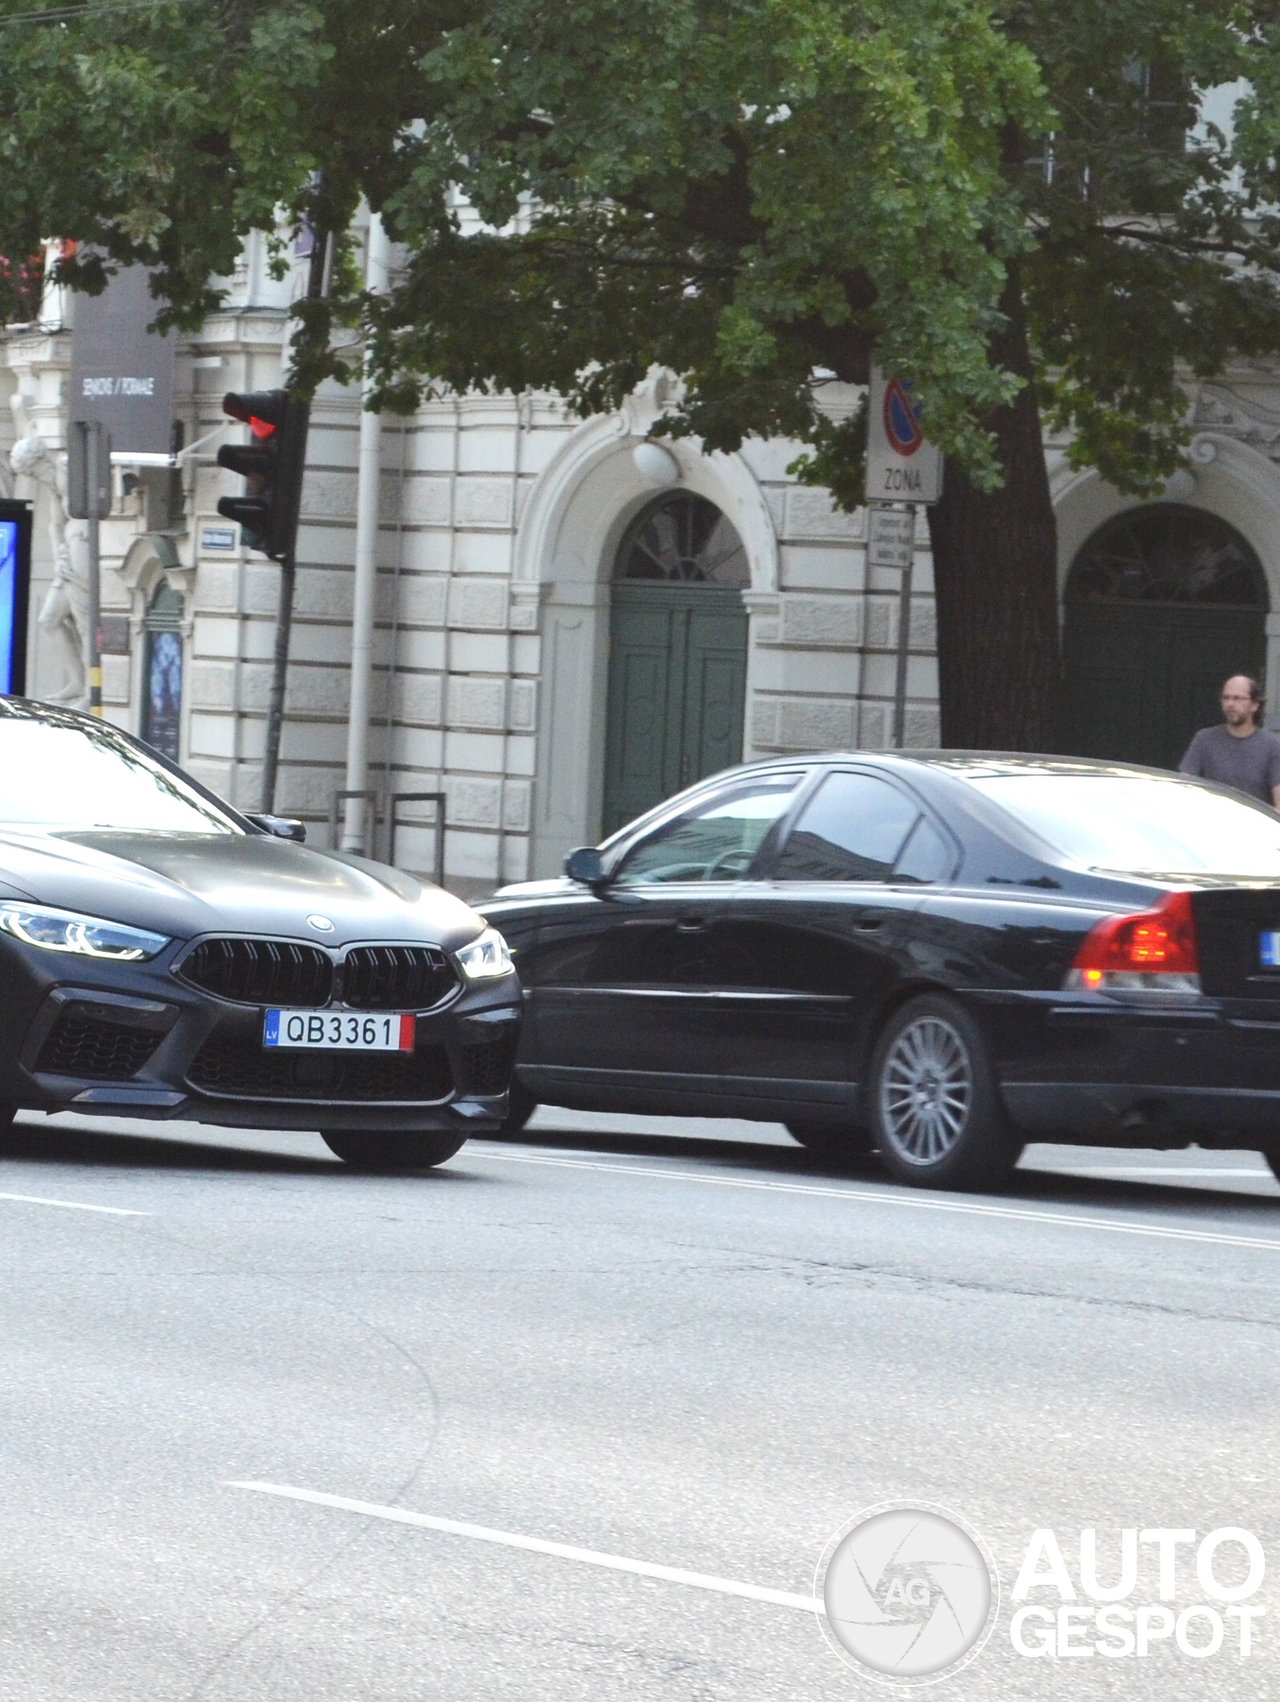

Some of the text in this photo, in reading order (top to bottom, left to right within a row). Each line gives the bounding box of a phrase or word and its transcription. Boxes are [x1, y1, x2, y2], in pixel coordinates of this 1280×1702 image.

[884, 468, 922, 491] ZONA
[266, 1015, 391, 1046] LV QB3361
